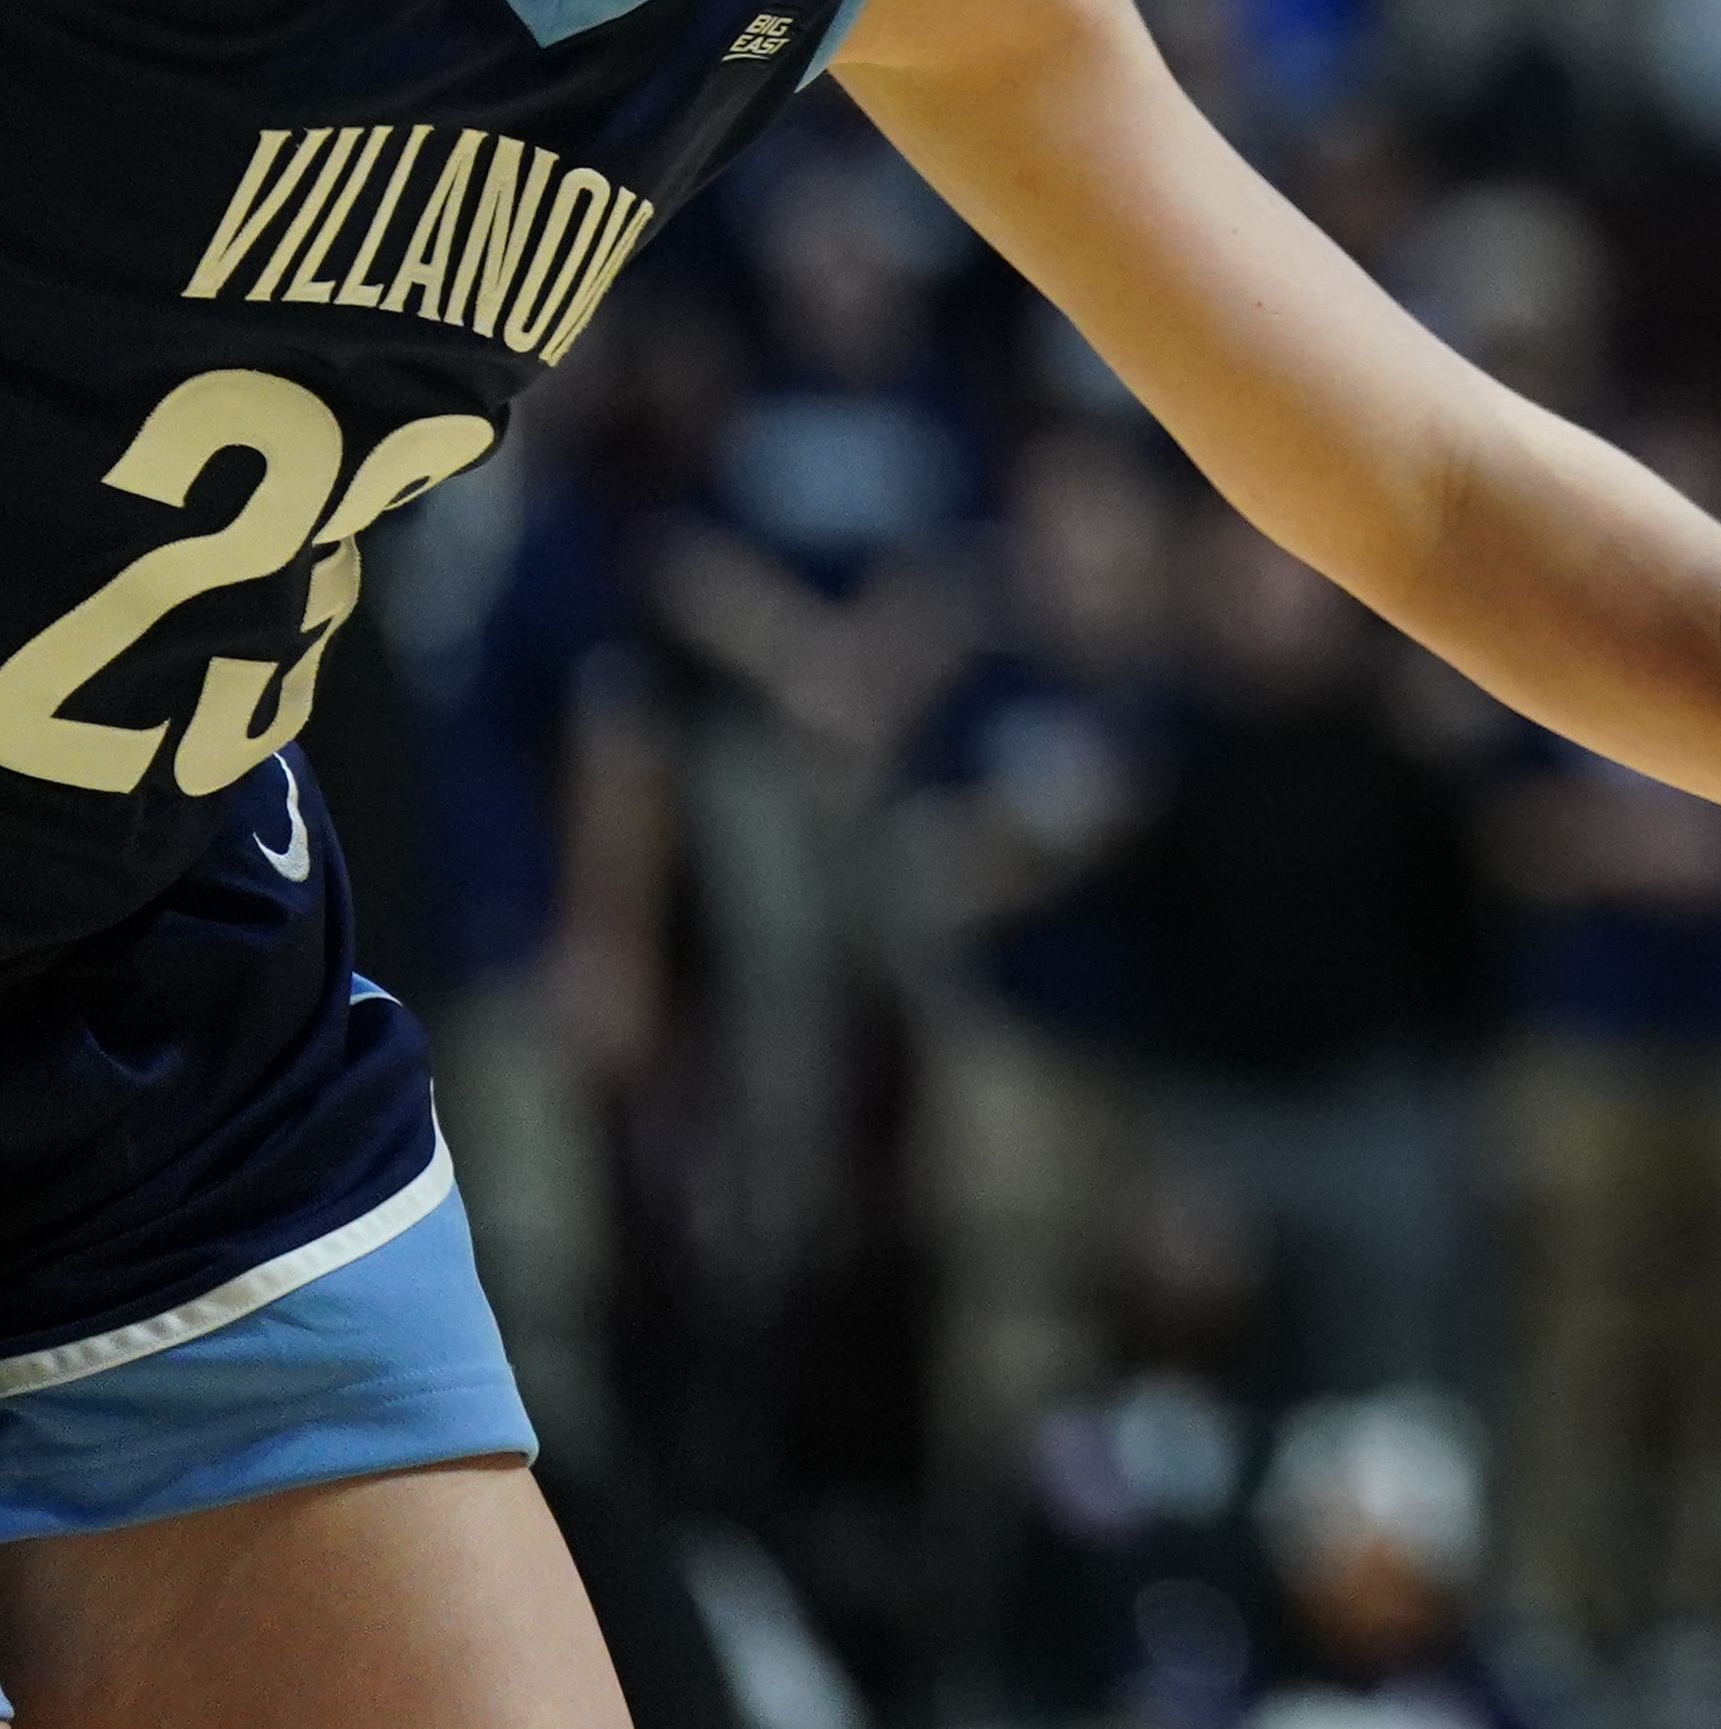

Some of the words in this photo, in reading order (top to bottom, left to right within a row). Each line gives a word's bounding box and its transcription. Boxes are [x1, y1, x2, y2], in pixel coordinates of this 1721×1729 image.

[729, 34, 792, 55] EAST
[745, 14, 794, 37] BIG
[180, 123, 655, 368] VILLANOV
[0, 368, 496, 798] 23
